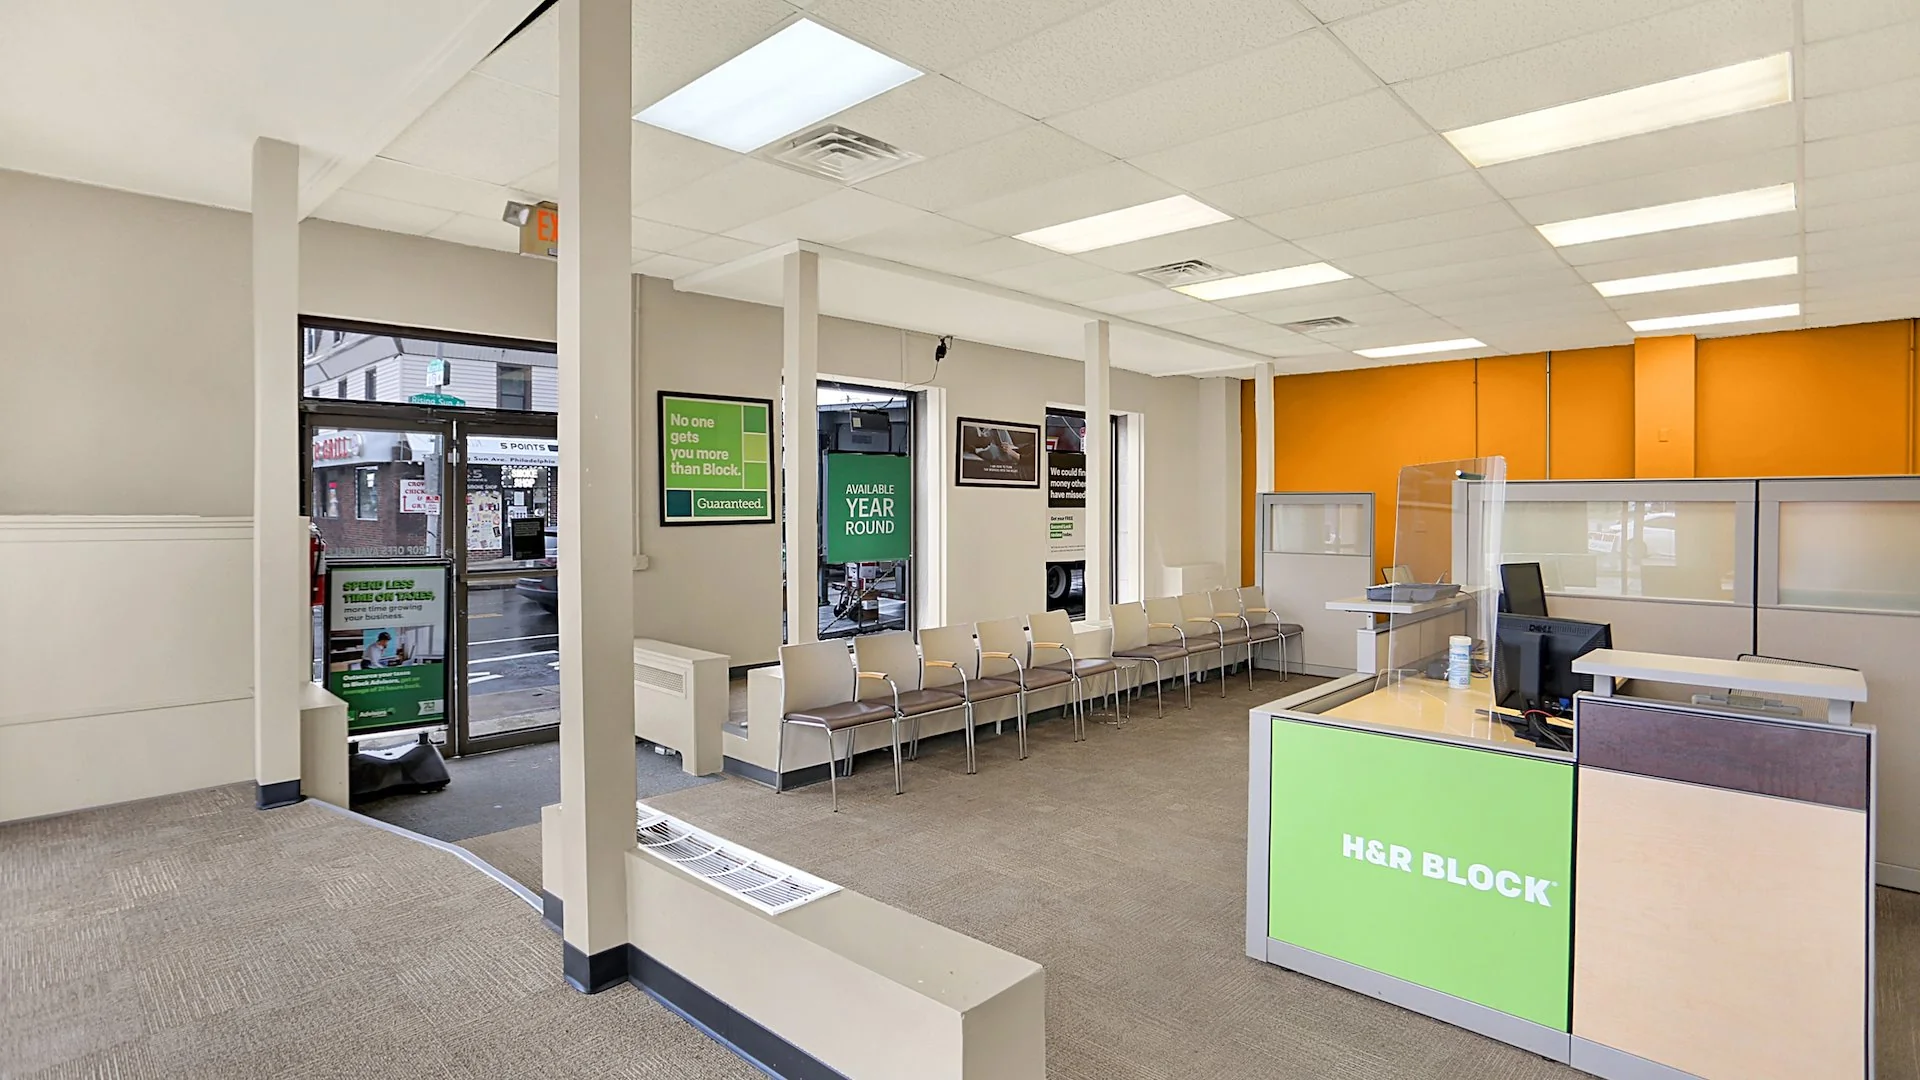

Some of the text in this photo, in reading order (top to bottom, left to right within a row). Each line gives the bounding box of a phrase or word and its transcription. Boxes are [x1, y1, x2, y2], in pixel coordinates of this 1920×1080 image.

[671, 413, 715, 428] No one
[671, 431, 699, 445] gets
[500, 442, 546, 451] 5 POINTS
[671, 448, 729, 460] you more
[511, 468, 539, 478] SMOKE
[671, 461, 742, 476] than Block.
[1050, 467, 1060, 476] We
[1061, 468, 1077, 476] could
[513, 478, 536, 488] SHOP
[1050, 480, 1071, 489] money
[846, 484, 895, 495] AVAILABLE
[1050, 490, 1065, 499] have
[697, 498, 764, 509] Guaranteed.
[846, 498, 895, 518] YEAR
[846, 520, 895, 536] ROUND
[342, 580, 415, 591] SPEND LESS
[342, 593, 374, 603] TIME
[374, 592, 395, 602] ON
[368, 604, 387, 612] time
[389, 603, 423, 613] growing
[344, 612, 405, 623] your business.
[1342, 833, 1412, 873] H&R
